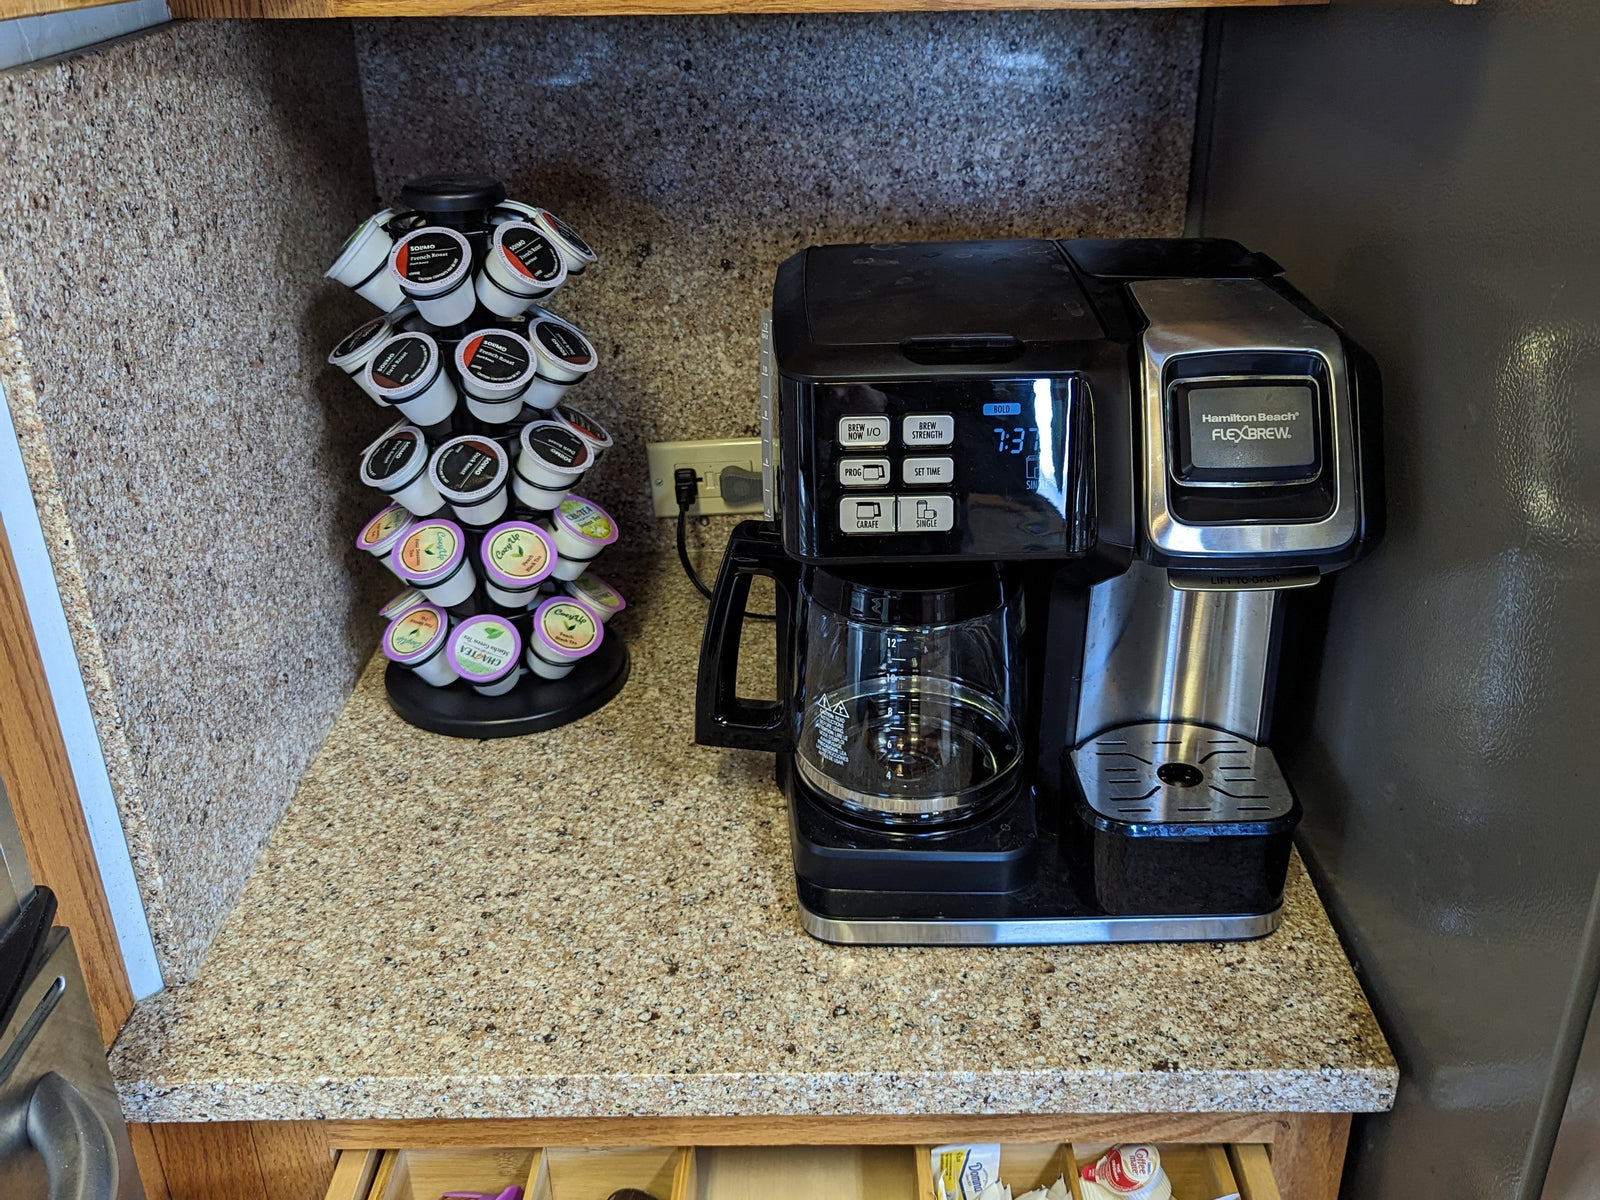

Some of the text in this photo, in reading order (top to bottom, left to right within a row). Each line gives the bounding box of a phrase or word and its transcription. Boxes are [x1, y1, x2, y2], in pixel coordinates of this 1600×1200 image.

[479, 348, 499, 359] French
[386, 364, 397, 376] Dark
[993, 405, 1010, 414] BOLD
[1202, 413, 1256, 423] Hamilton
[848, 424, 865, 432] BREW
[919, 422, 936, 430] BREW
[848, 432, 864, 440] NOW
[912, 431, 943, 439] STRENGTH
[1212, 425, 1289, 443] FLEXBREW
[994, 428, 1039, 454] 7:37
[470, 452, 482, 463] Dark
[915, 467, 940, 476] SET TIME
[857, 520, 878, 528] CARAFE
[1210, 575, 1280, 584] LIFT TO OPEN
[474, 639, 490, 649] Green
[887, 638, 896, 648] 12
[887, 674, 896, 683] 10
[888, 707, 893, 716] 8
[887, 740, 892, 748] 6
[886, 771, 892, 780] 4
[1129, 1156, 1138, 1175] mate
[1135, 1147, 1149, 1175] Coffee
